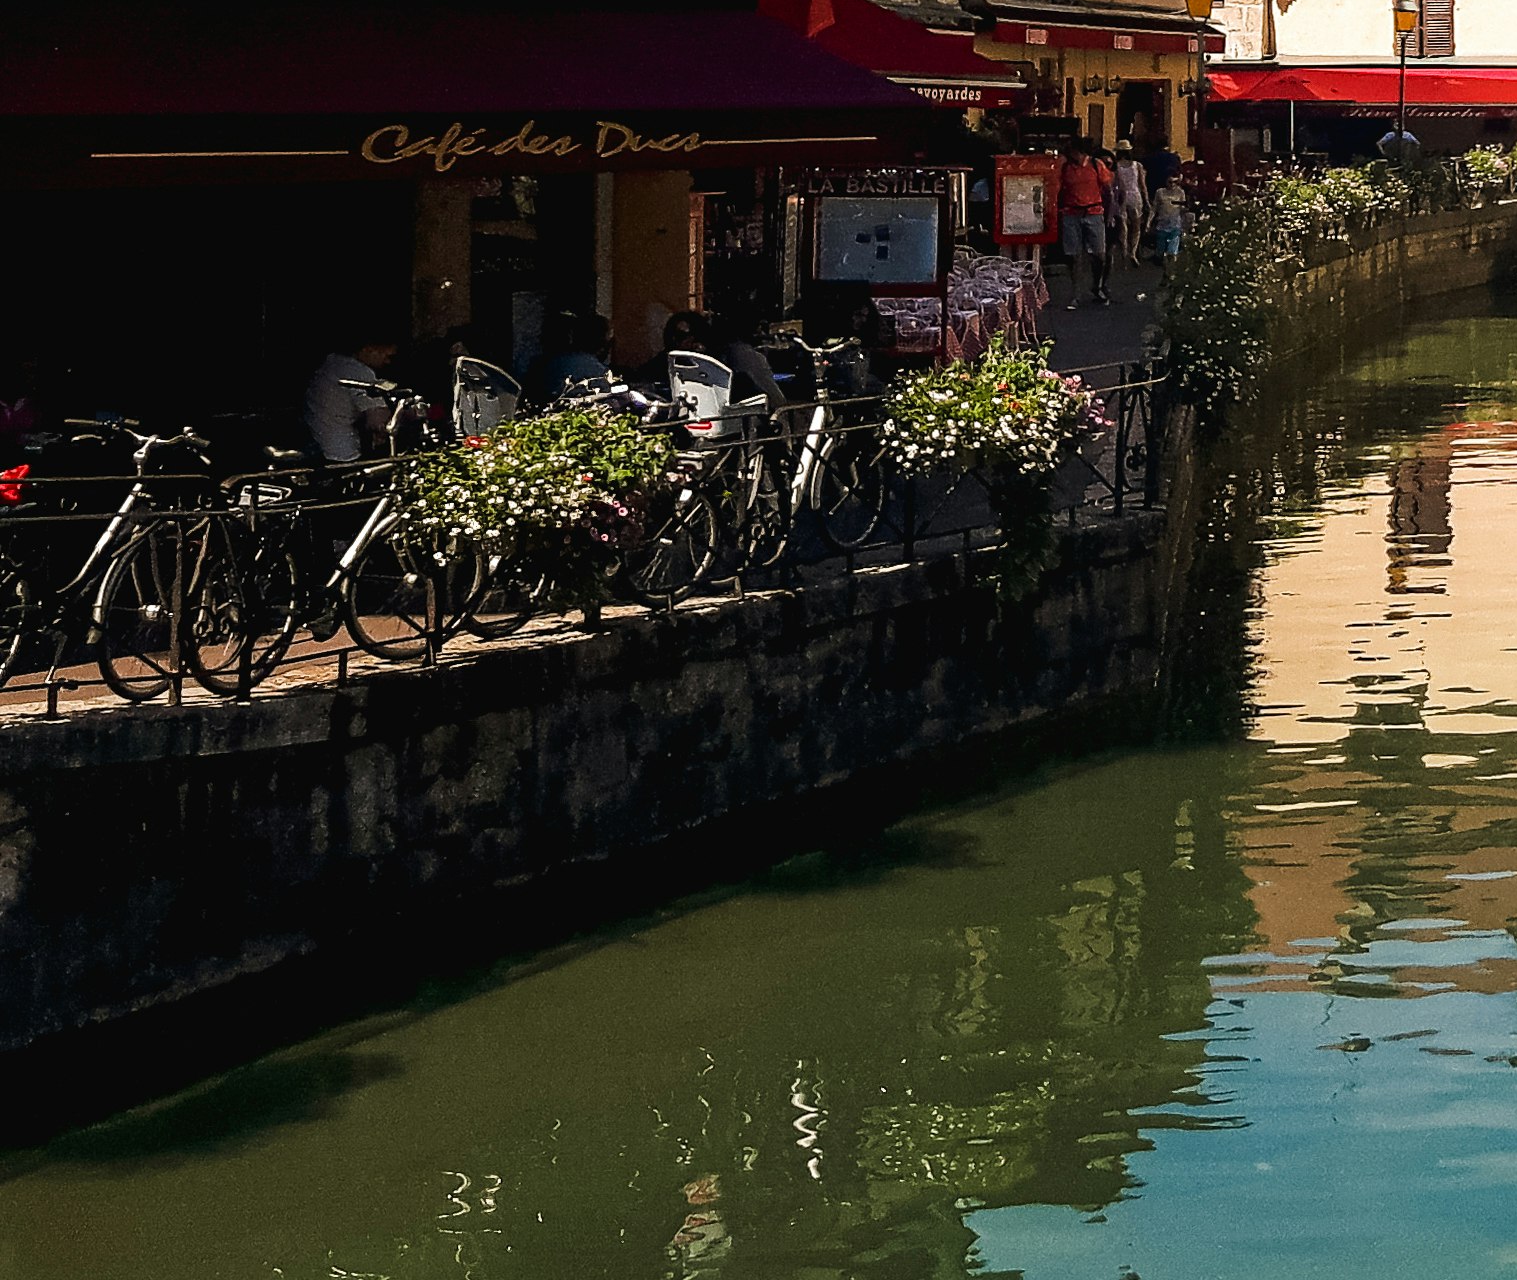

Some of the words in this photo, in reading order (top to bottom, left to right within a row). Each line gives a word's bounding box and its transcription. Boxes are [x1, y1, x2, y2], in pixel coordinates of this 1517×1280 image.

[361, 121, 488, 172] Café
[487, 119, 582, 157] des
[596, 120, 702, 158] Ducs
[807, 178, 835, 194] LA
[846, 177, 946, 195] BASTILLE
